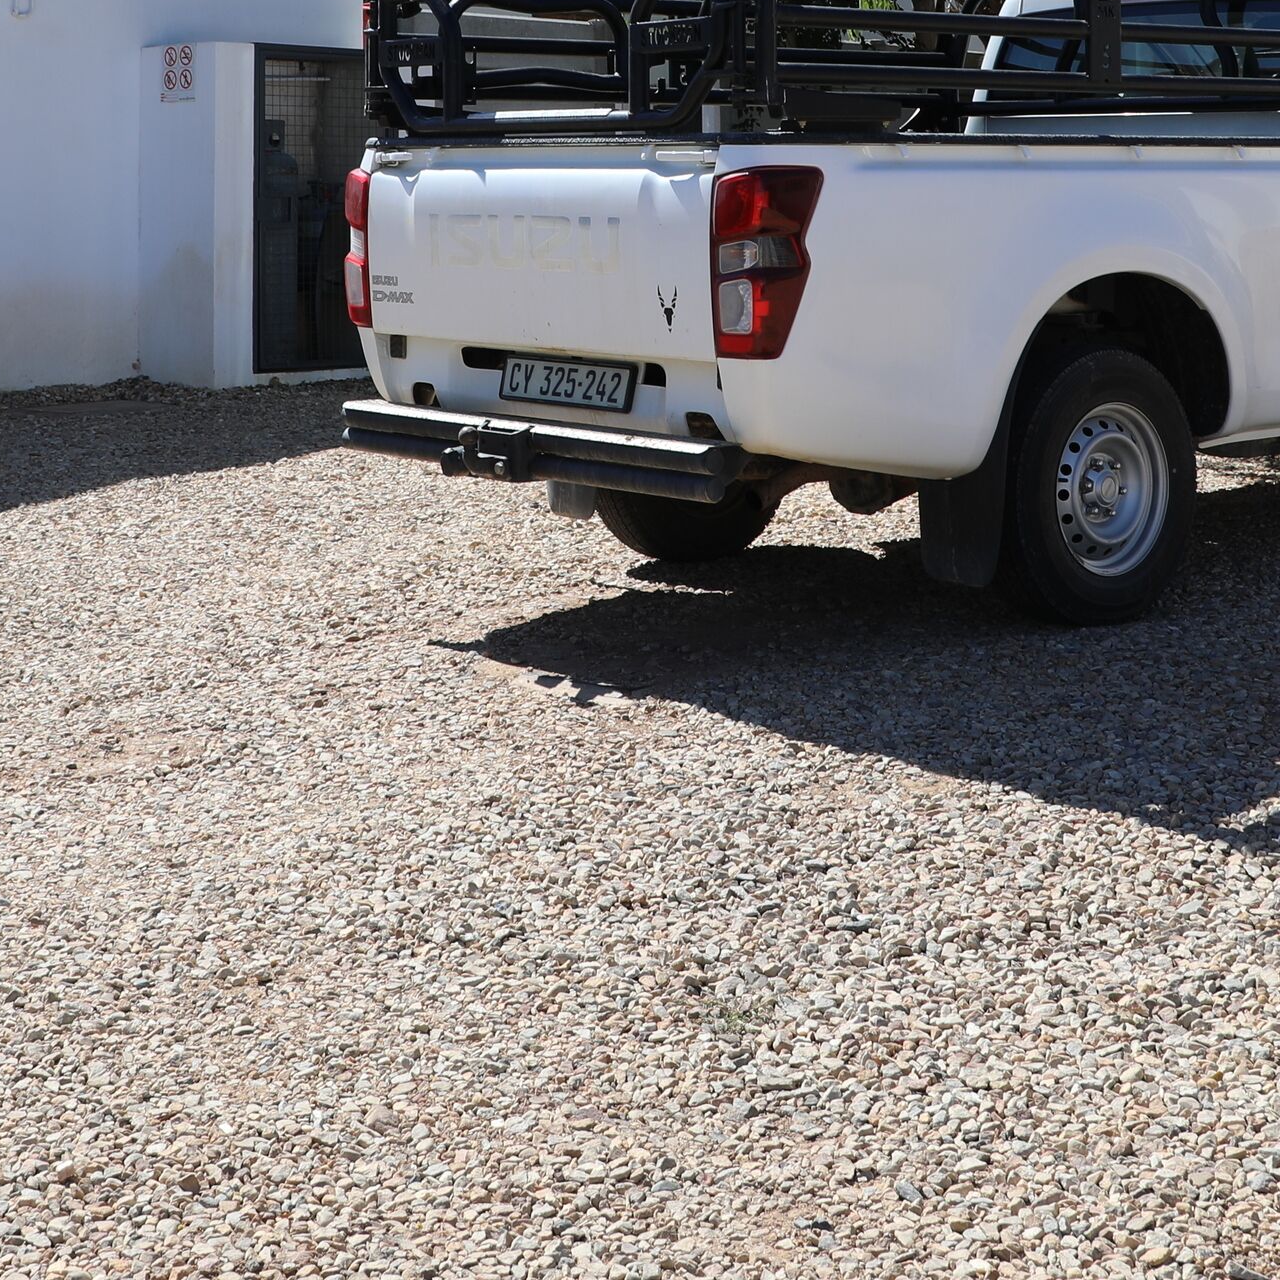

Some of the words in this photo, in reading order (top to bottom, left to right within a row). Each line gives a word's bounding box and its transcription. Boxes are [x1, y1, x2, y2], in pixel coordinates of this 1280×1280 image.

[430, 213, 620, 273] ISUZU
[372, 275, 398, 286] ISUZU
[509, 363, 535, 394] CY
